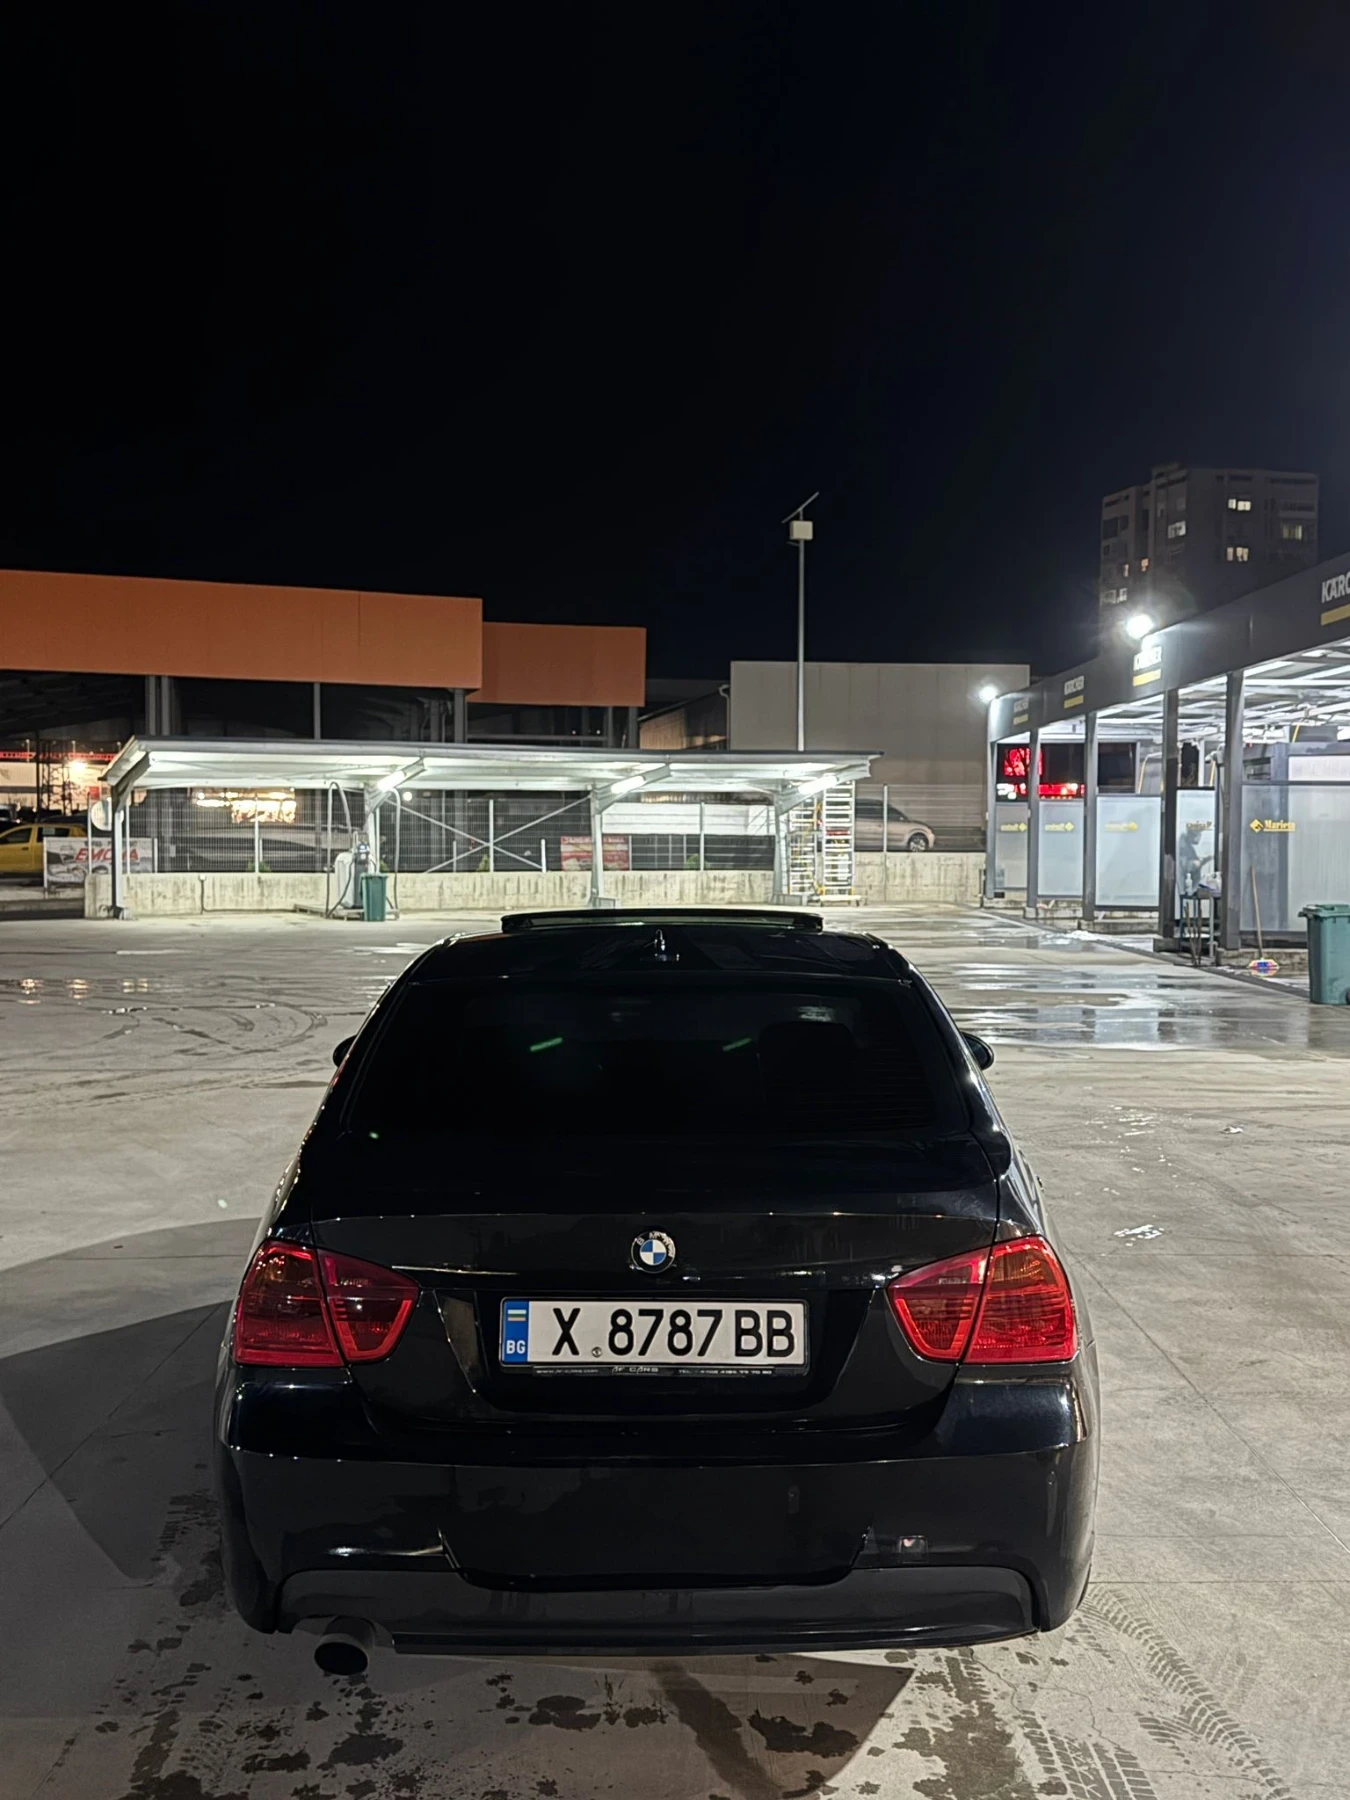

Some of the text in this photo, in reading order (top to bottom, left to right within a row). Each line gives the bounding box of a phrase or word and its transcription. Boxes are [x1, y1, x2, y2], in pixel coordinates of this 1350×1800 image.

[506, 1340, 526, 1355] BG
[552, 1307, 795, 1358] X 8787 BB
